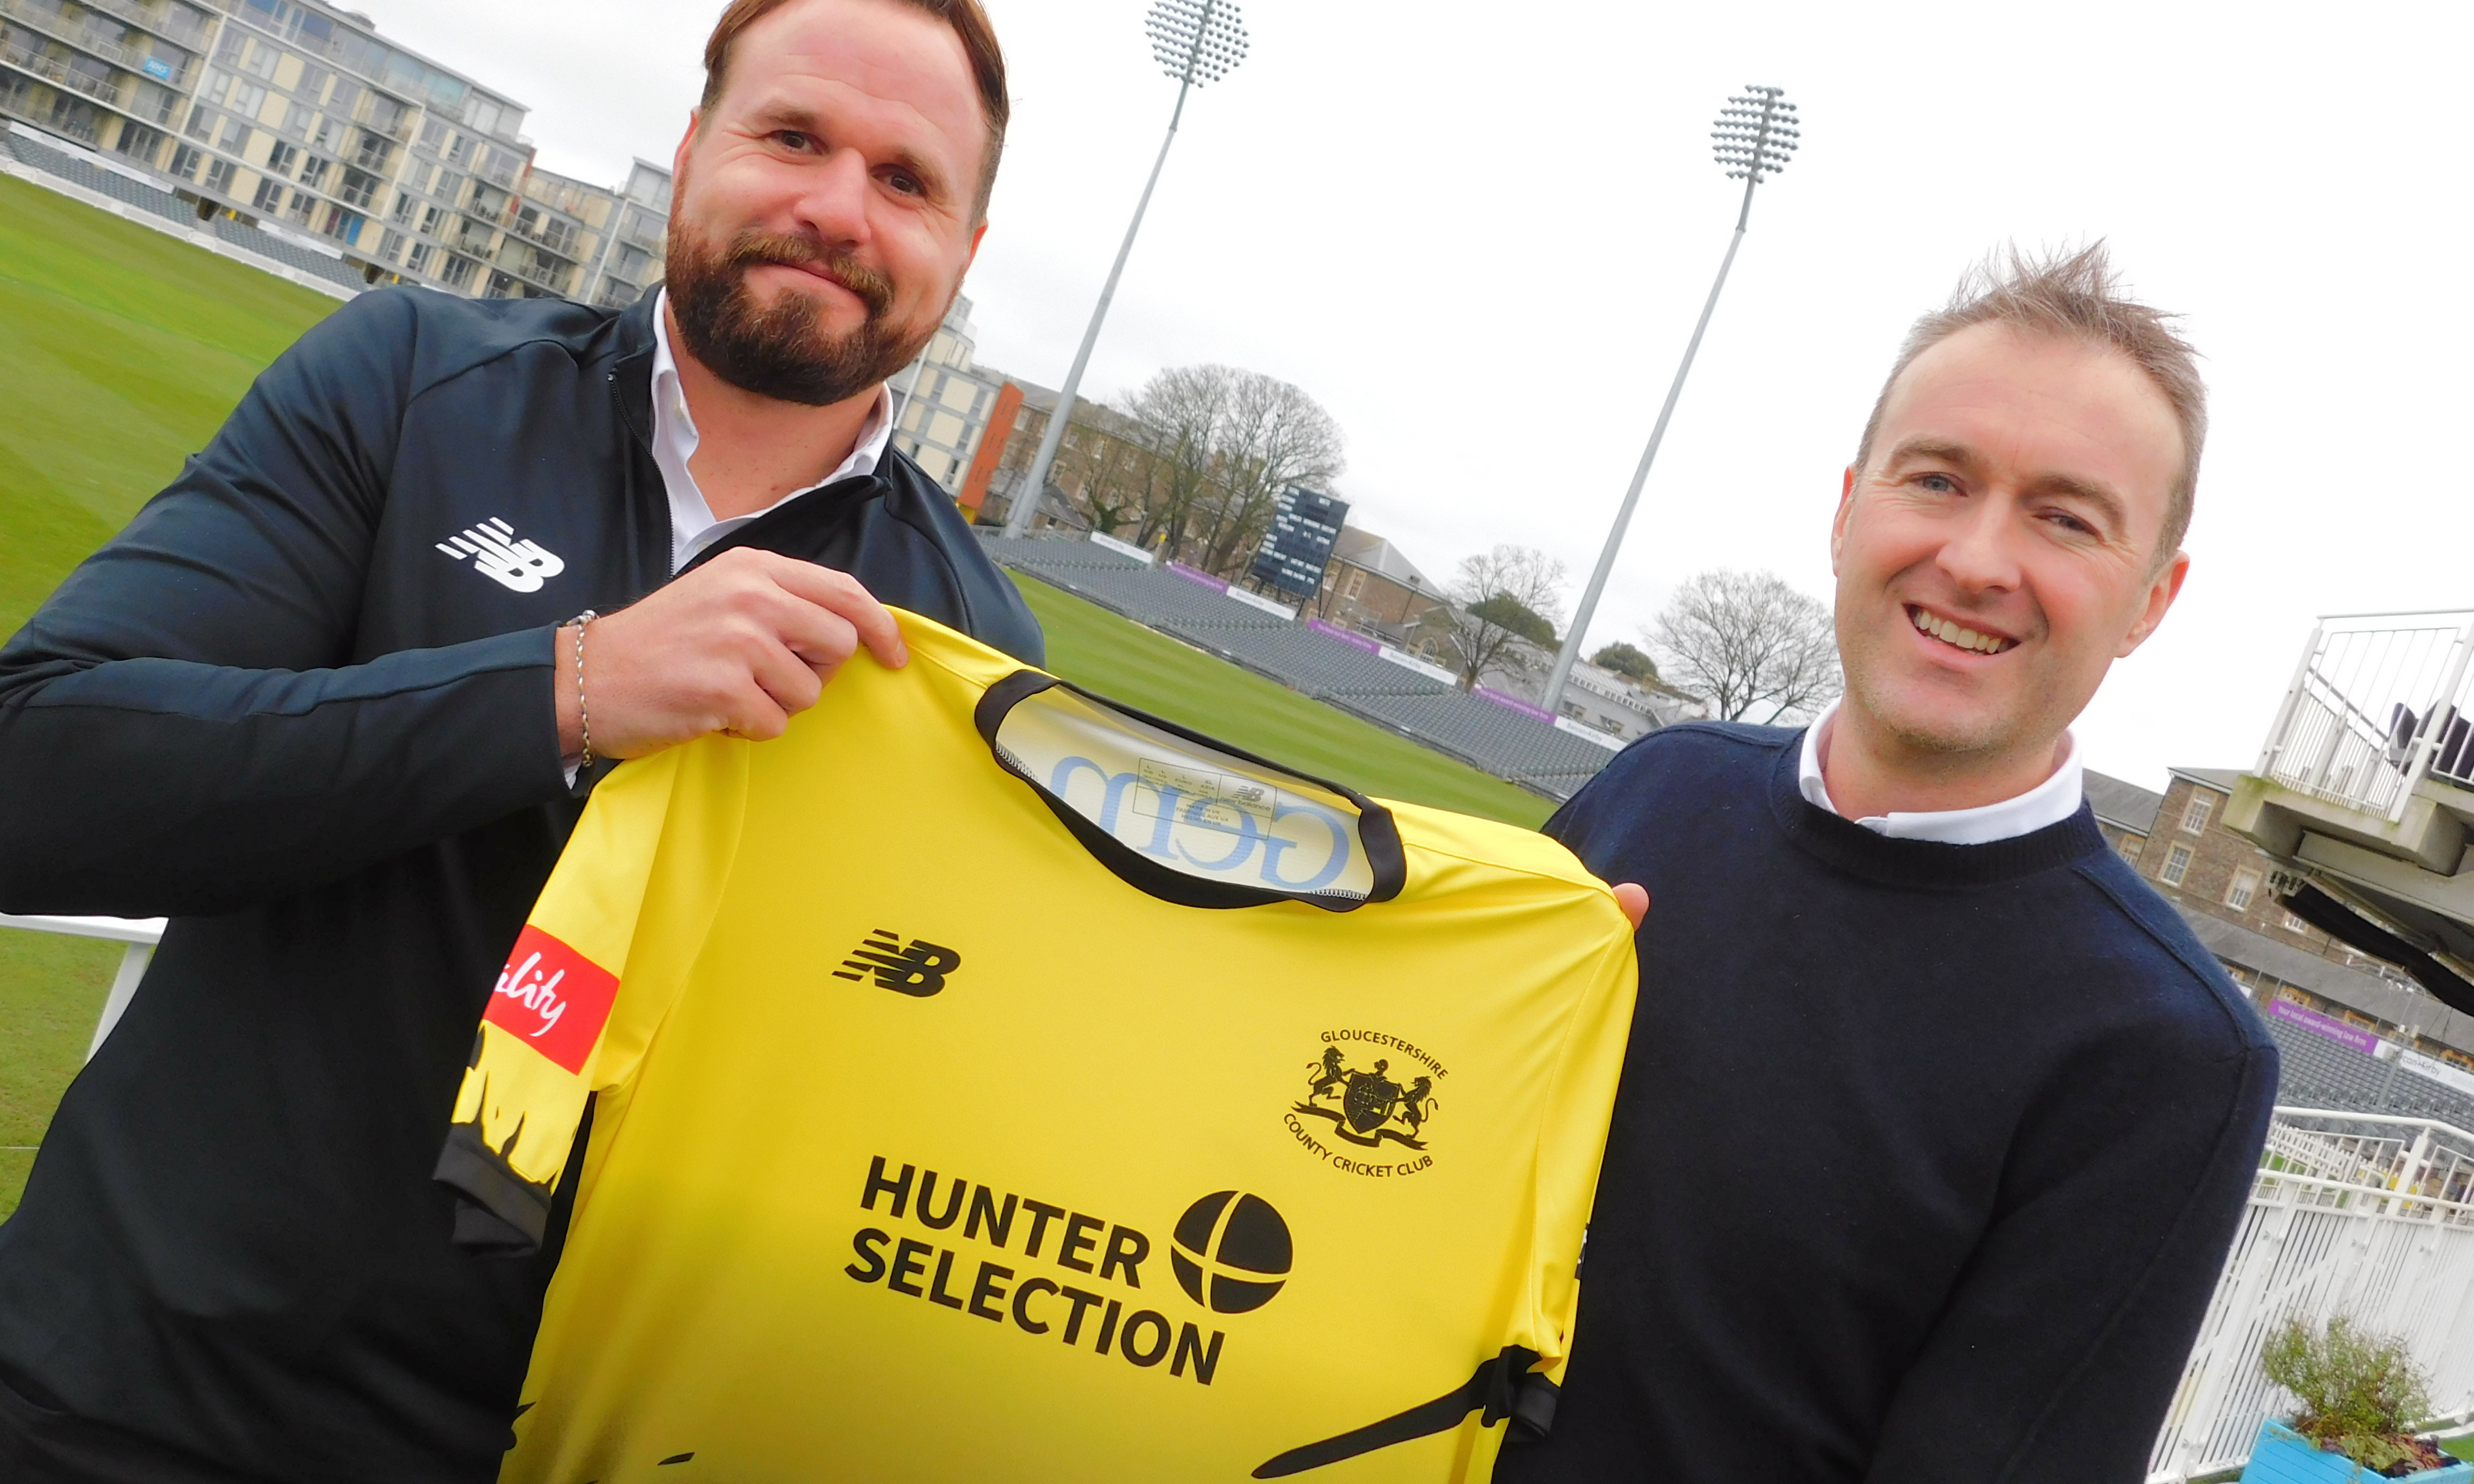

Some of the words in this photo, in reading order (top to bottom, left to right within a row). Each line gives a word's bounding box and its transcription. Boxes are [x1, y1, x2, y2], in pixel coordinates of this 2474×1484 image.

[1182, 814, 1202, 822] HECHO
[1238, 800, 1271, 811] balance
[2290, 1010, 2304, 1022] local
[2354, 1035, 2367, 1046] firm
[1321, 1029, 1448, 1080] GLOUCESTERSHIRE
[1284, 1113, 1332, 1161] COUNTY
[1333, 1156, 1392, 1178] CRICKET
[1397, 1155, 1433, 1177] CLUB
[860, 1155, 1150, 1289] HUNTER
[844, 1228, 1225, 1386] SELECTION
